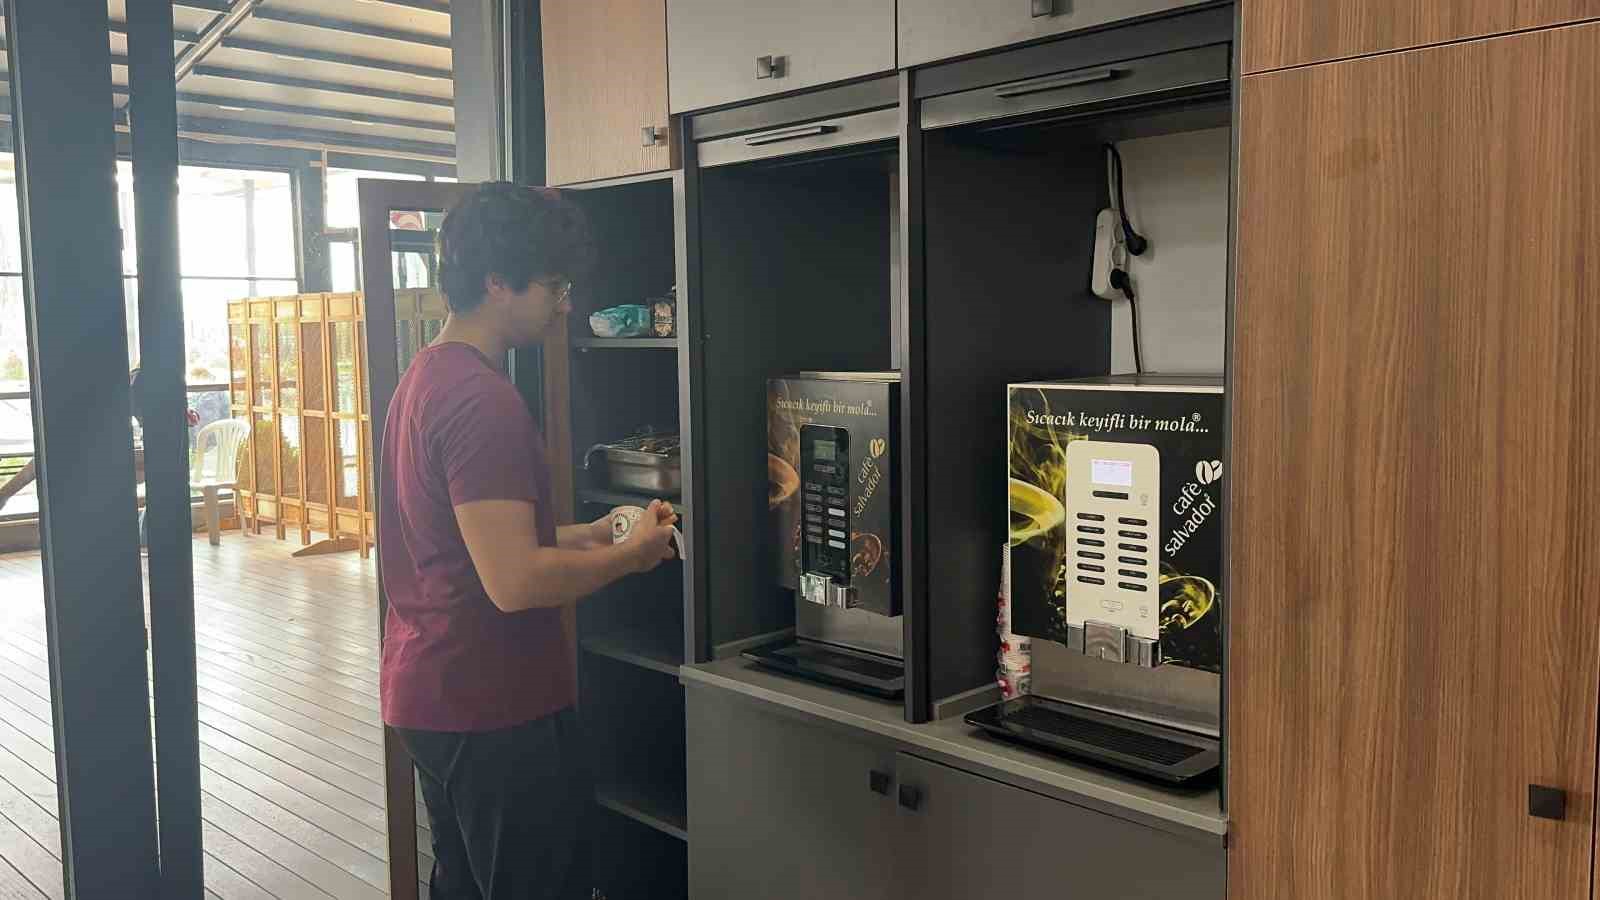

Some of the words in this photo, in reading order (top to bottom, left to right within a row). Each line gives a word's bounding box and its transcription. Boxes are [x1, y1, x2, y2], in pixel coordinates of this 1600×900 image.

[833, 400, 846, 413] bir
[1026, 410, 1075, 426] Sıcacık
[1079, 412, 1125, 432] keyifli
[1129, 414, 1151, 430] bir
[1164, 494, 1215, 557] salvador
